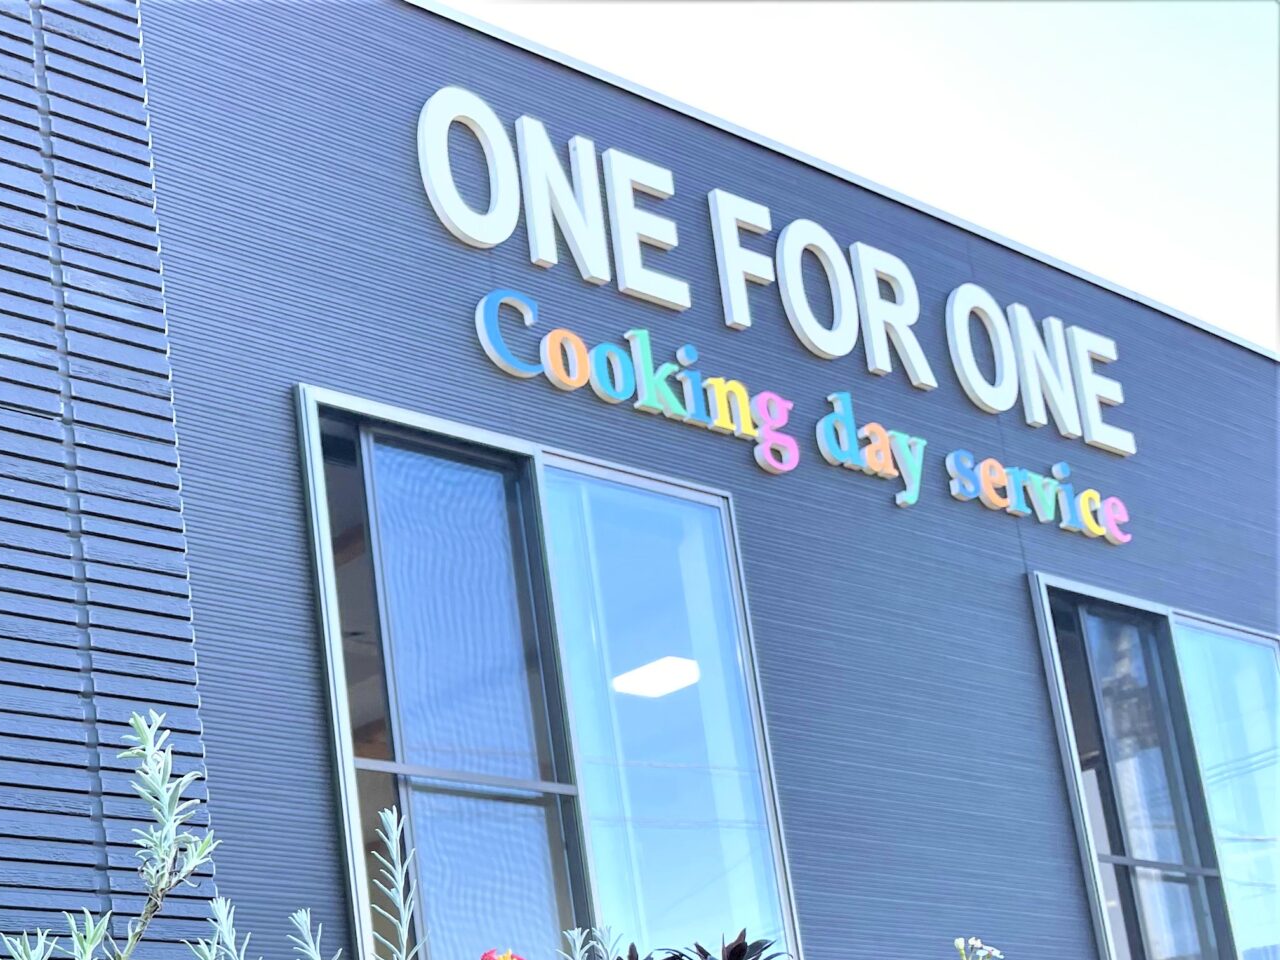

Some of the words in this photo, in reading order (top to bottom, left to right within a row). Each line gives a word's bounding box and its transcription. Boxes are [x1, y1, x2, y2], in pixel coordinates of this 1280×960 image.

[417, 86, 692, 311] ONE
[708, 188, 939, 390] FOR
[945, 283, 1137, 456] ONE
[475, 288, 800, 475] Cooking
[816, 392, 928, 508] day
[946, 449, 1133, 545] service
